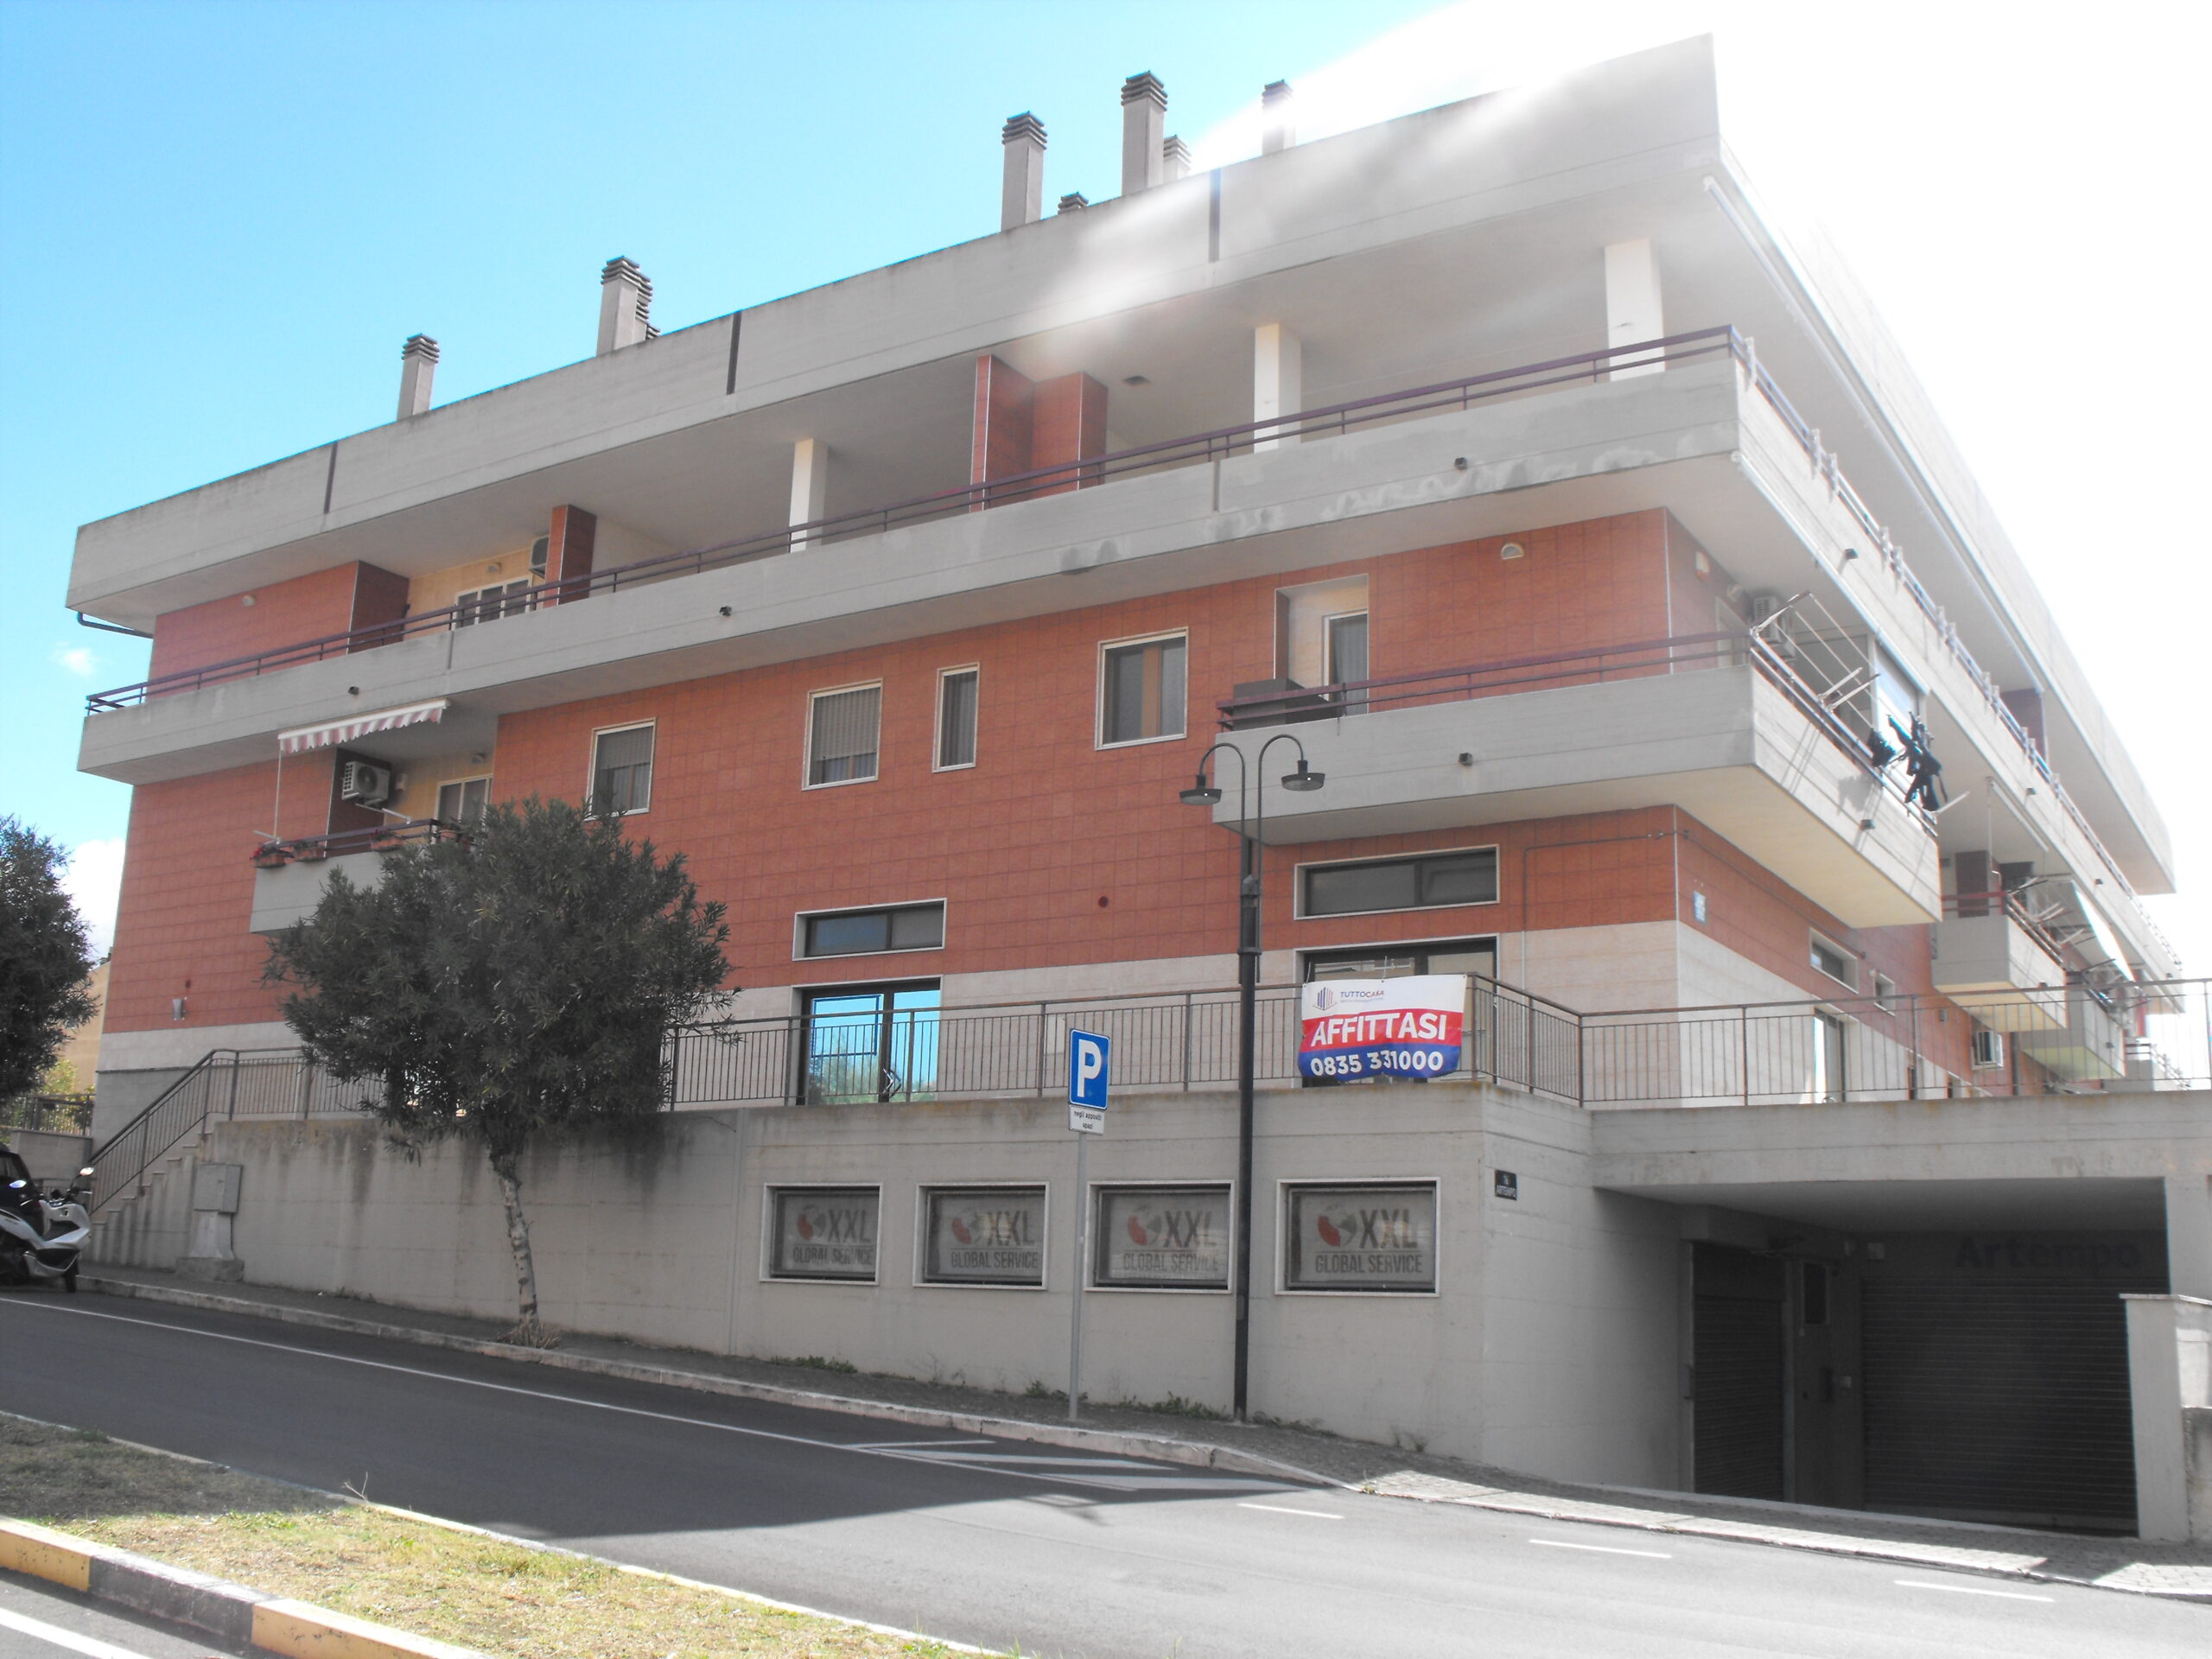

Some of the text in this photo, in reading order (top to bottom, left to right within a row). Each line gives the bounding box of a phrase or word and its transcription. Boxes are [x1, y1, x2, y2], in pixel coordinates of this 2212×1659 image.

[1311, 1013, 1446, 1046] AFFITTASI
[1077, 1039, 1102, 1097] P
[1311, 1050, 1444, 1076] 0835 331000
[828, 1209, 871, 1243] XXL
[987, 1211, 1035, 1246] XXL
[1163, 1210, 1217, 1248] XXL
[1359, 1209, 1419, 1249] XXL
[793, 1245, 874, 1266] GLOBAL SERVICE
[951, 1250, 1039, 1270] GLOBAL SERVICE
[1123, 1253, 1219, 1273] GLOBAL SERVICE
[1315, 1254, 1423, 1274] GLOBAL SERVICE
[1955, 1236, 2142, 1277] Artempo
